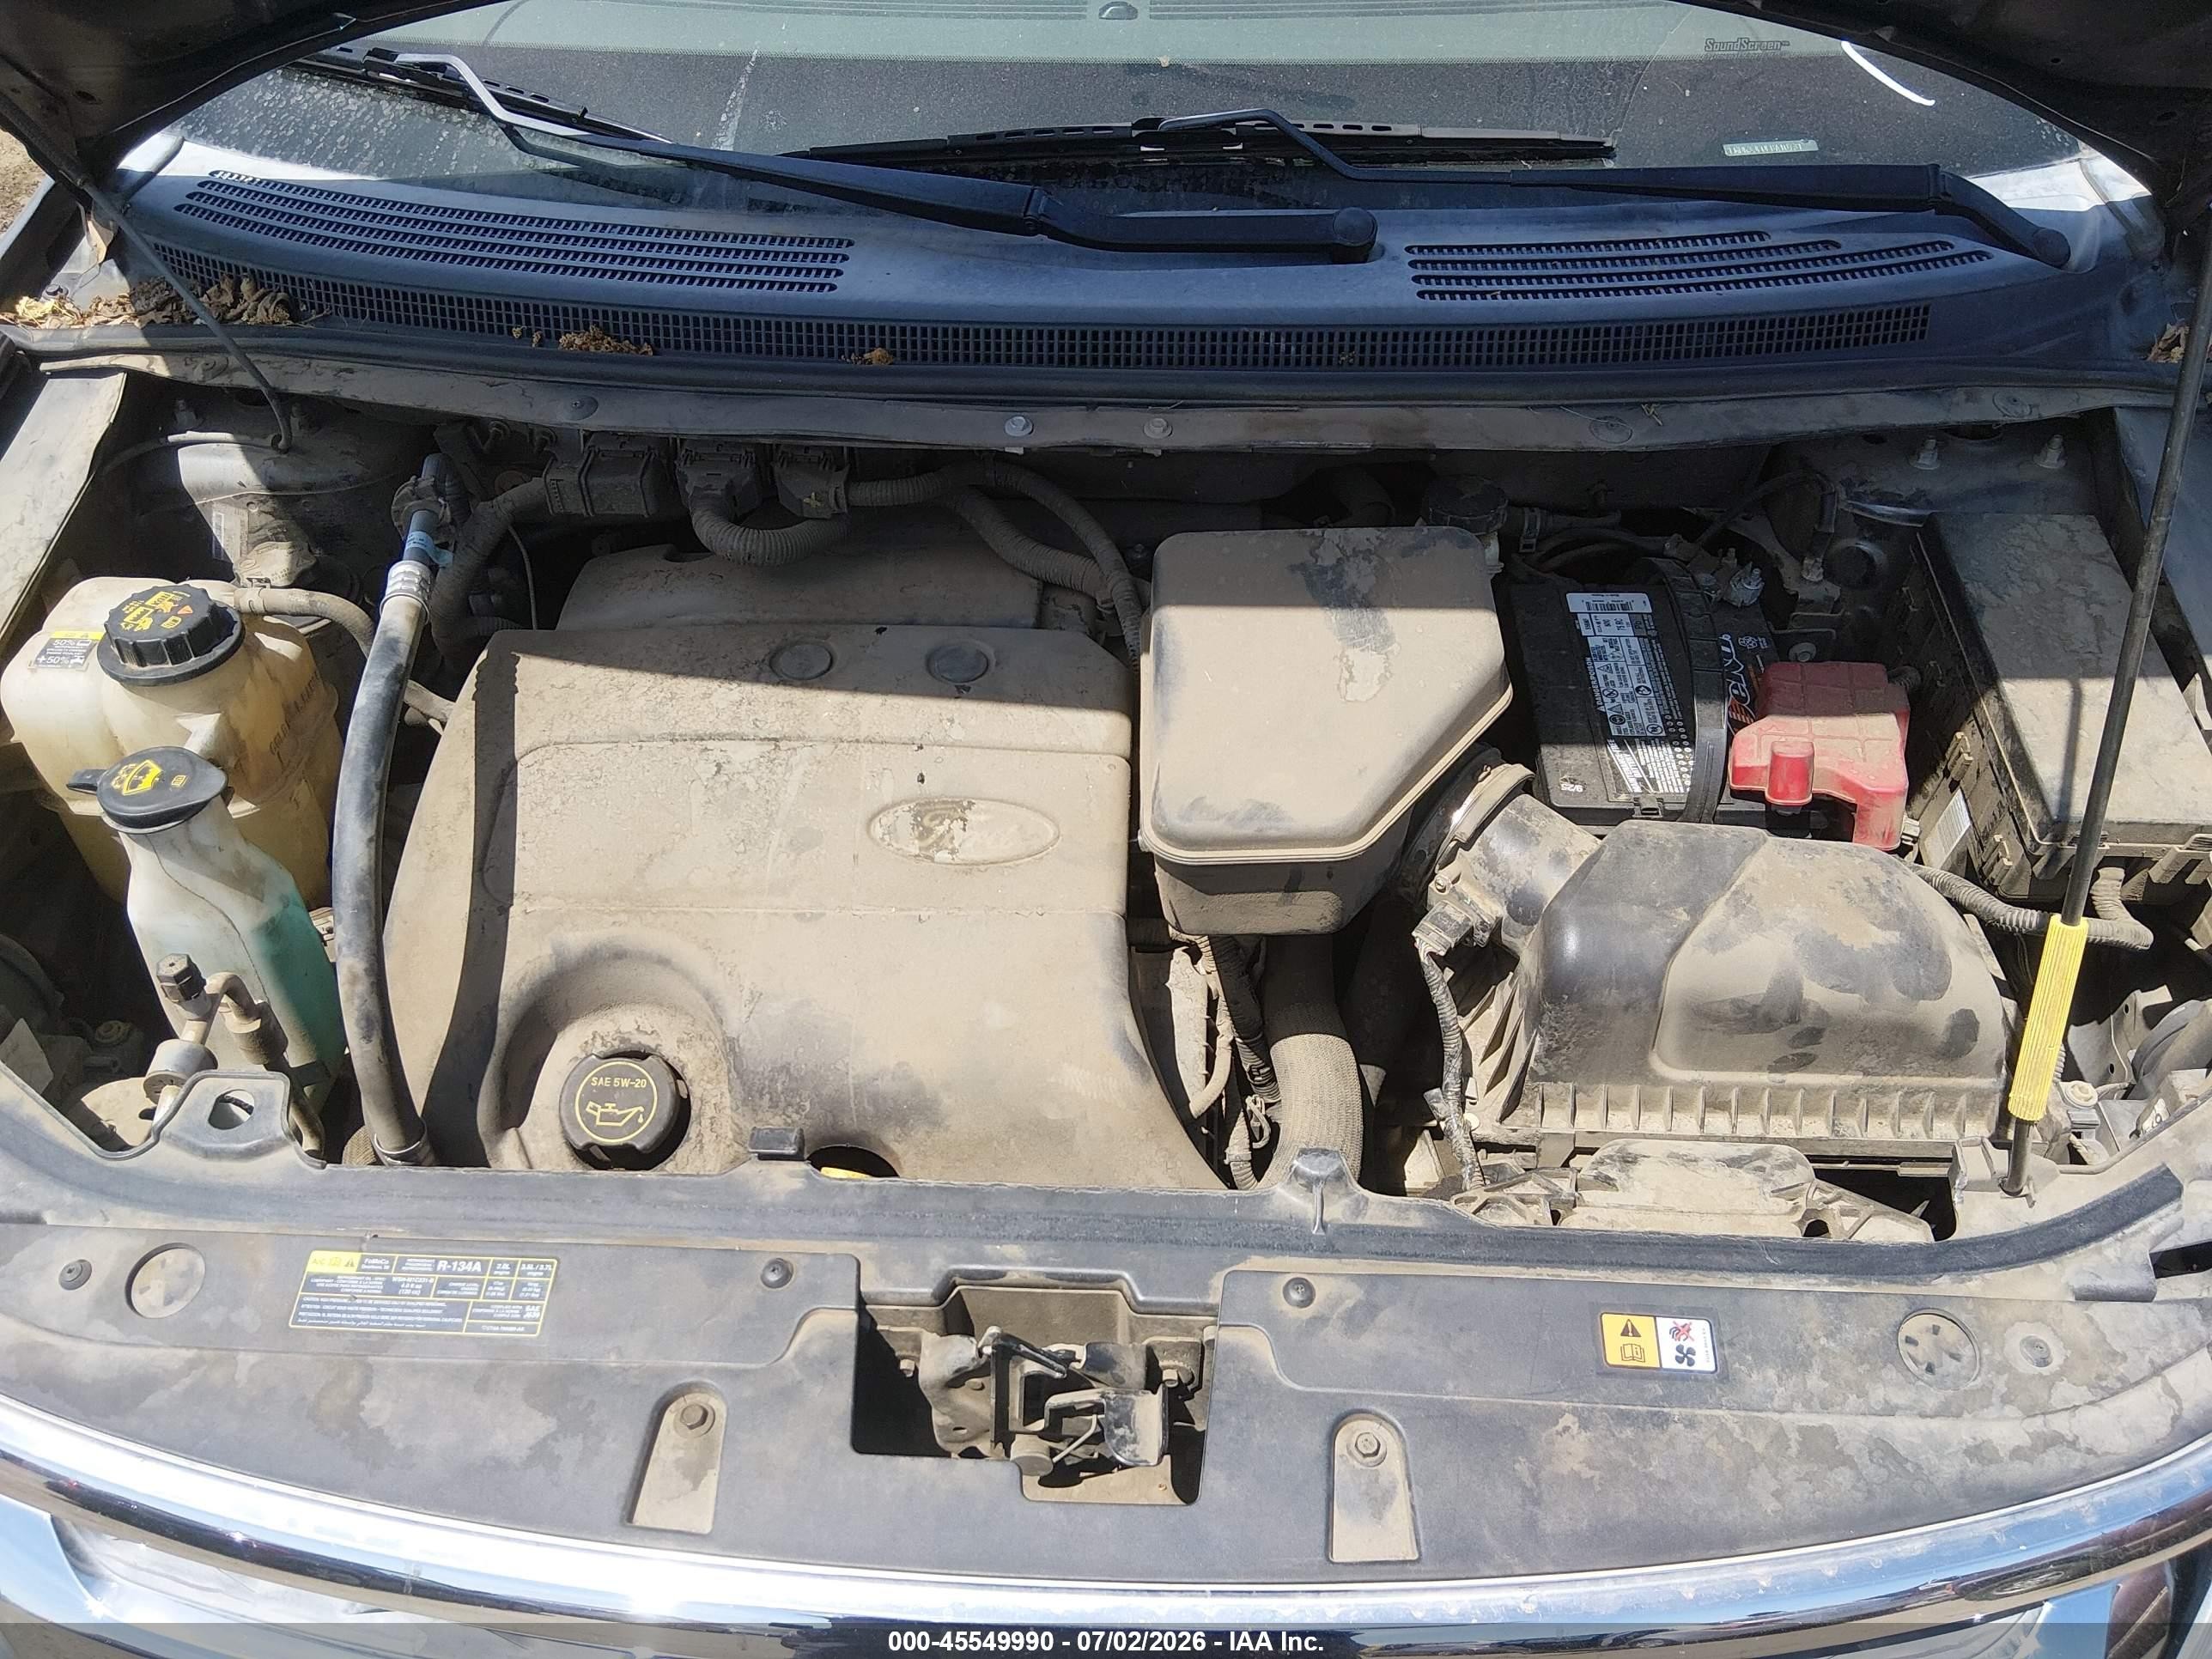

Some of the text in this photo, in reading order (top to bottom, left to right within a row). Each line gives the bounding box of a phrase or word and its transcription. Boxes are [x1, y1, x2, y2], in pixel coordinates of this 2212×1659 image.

[1560, 782, 1583, 793] 9/25
[591, 1077, 647, 1088] SAE 5W-20
[436, 1260, 482, 1272] R-134A
